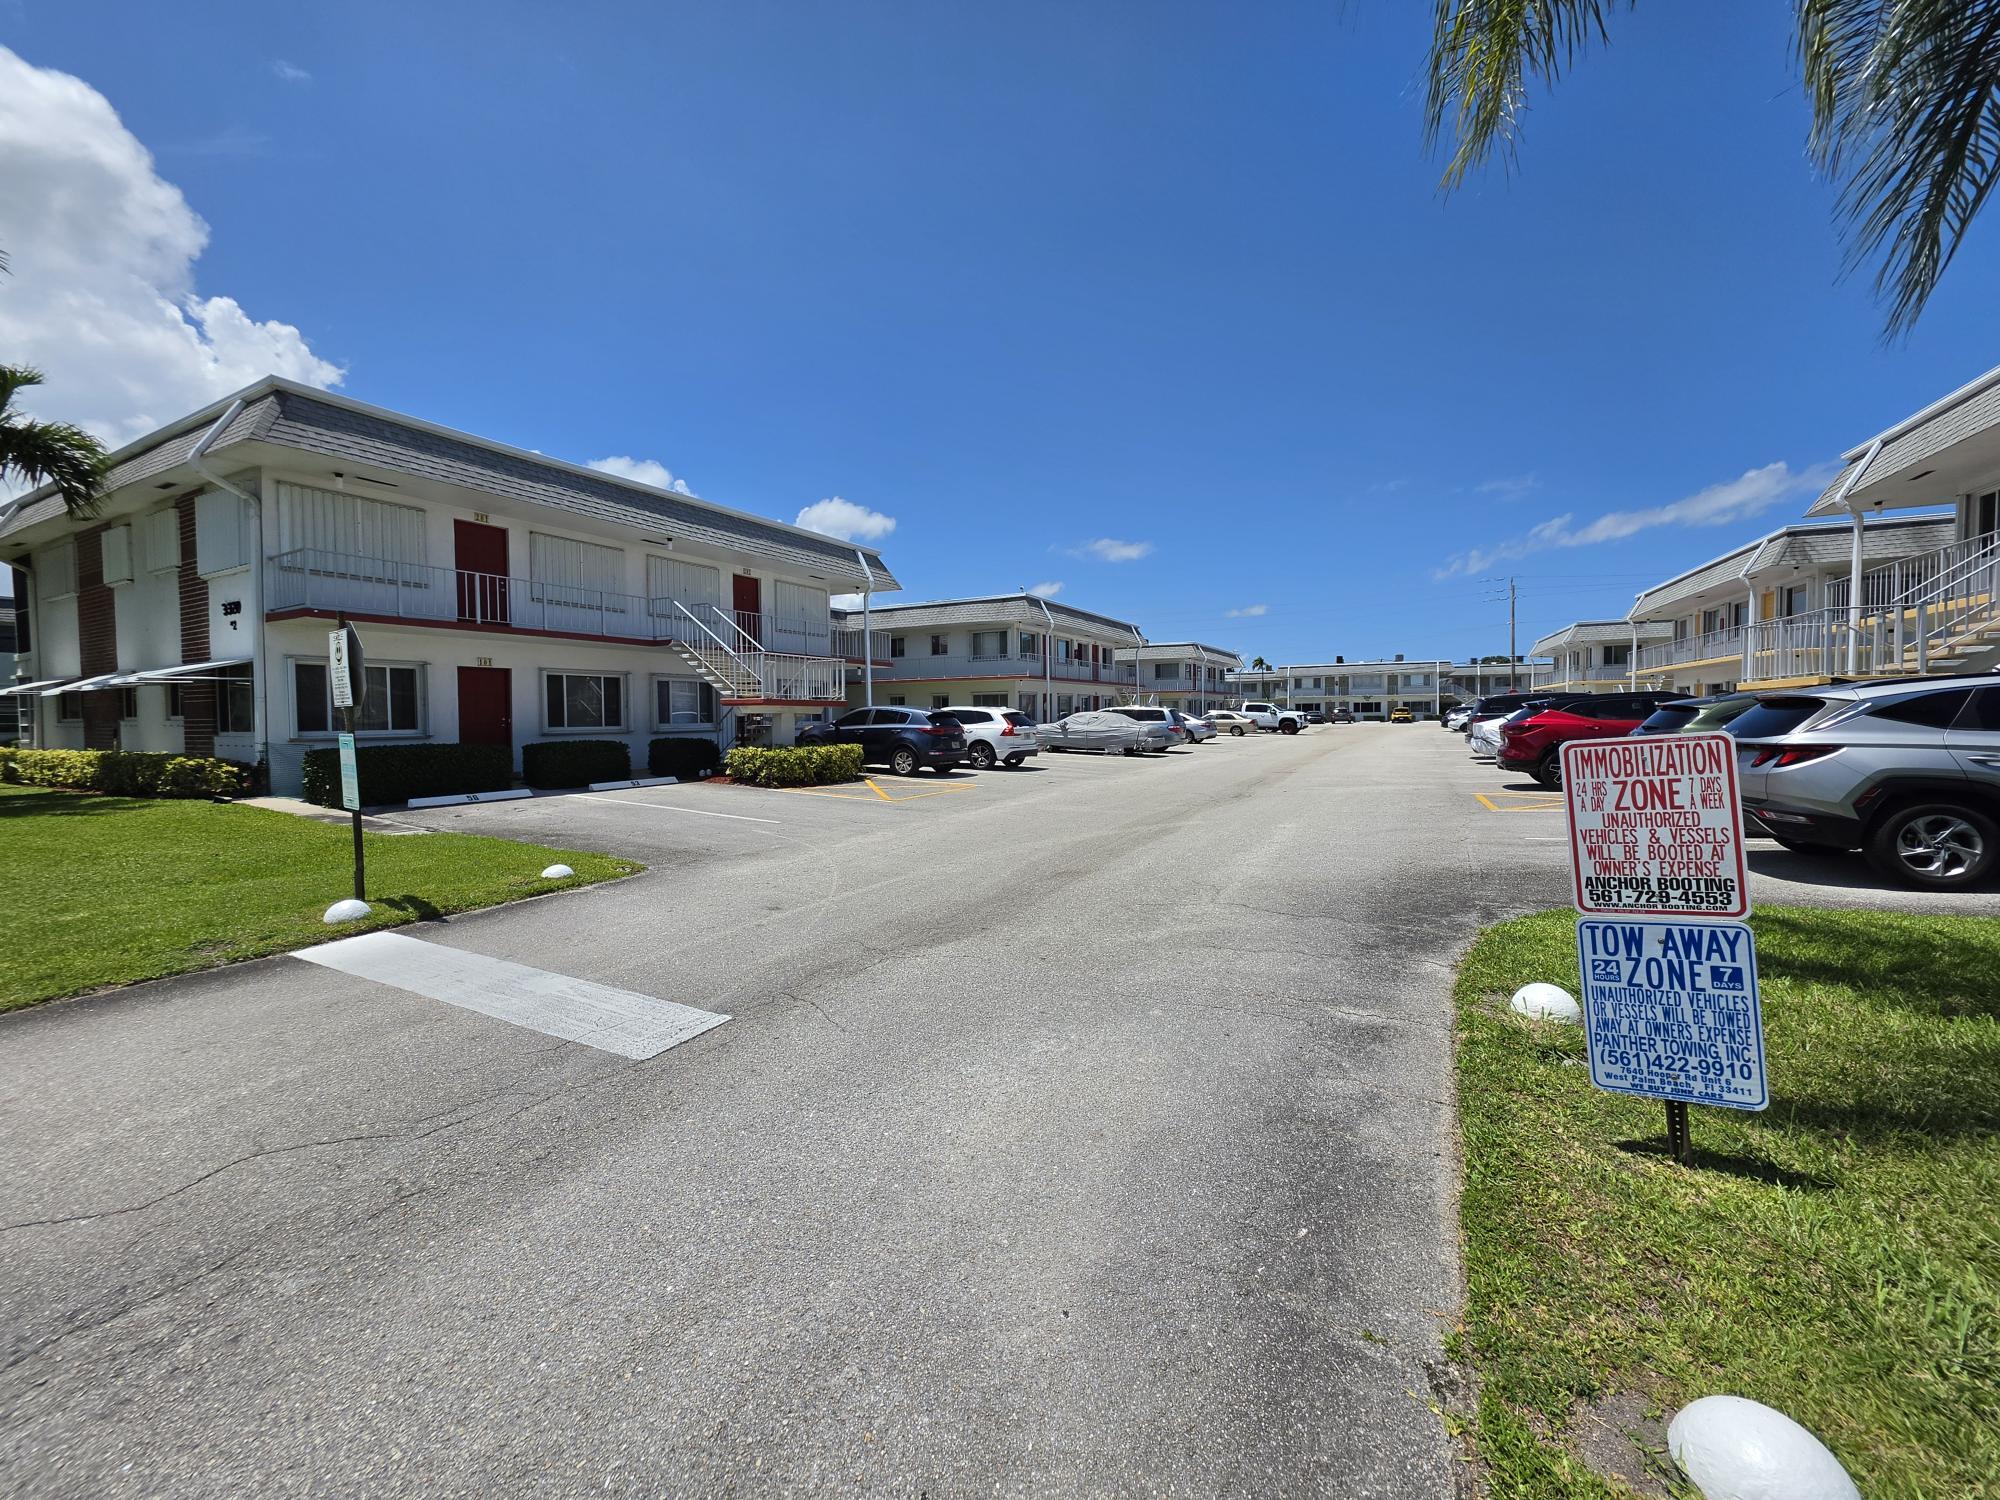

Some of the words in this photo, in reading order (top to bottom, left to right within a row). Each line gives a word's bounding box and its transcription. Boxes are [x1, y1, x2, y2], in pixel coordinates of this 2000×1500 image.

[1574, 742, 1723, 779] IMMOBILIZATION
[1576, 782, 1587, 797] 24
[1591, 781, 1607, 796] HRS
[1688, 778, 1695, 793] 7
[1700, 777, 1722, 792] DAYS
[1612, 778, 1685, 811] ZONE
[1690, 794, 1697, 810] A
[1700, 793, 1725, 809] WEEK
[1581, 797, 1587, 812] A
[1591, 796, 1605, 812] DAY
[1602, 811, 1700, 828] UNAUTHORIZED
[1579, 829, 1638, 844] VEHICLES
[1649, 829, 1661, 844] &
[1669, 827, 1730, 844] VESSELS
[1586, 845, 1615, 861] WILL
[1624, 845, 1641, 861] BE
[1648, 845, 1702, 861] BOOTED
[1711, 845, 1725, 861] AT
[1594, 861, 1651, 877] OWNER'S
[1659, 861, 1722, 877] EXPENSE
[1584, 877, 1652, 890] ANCHOR
[1657, 877, 1736, 892] BOOTING
[1661, 904, 1728, 912] BOOTING.COM
[1586, 925, 1644, 957] TOW
[1662, 928, 1742, 963] AWAY
[1593, 960, 1619, 975] 24
[1625, 957, 1706, 992] ZONE
[1719, 967, 1733, 983] 7
[1594, 974, 1620, 982] HOURS
[1713, 982, 1742, 990] DAYS
[1591, 986, 1681, 1007] UNAUTHORIZED
[1687, 992, 1749, 1013] VEHICLES
[1593, 1001, 1607, 1018] OR
[1611, 1003, 1657, 1021] VESSELS
[1662, 1007, 1688, 1024] WILL
[1692, 1009, 1707, 1026] BE
[1712, 1010, 1751, 1030] TOWED
[1595, 1017, 1623, 1034] AWAY
[1628, 1020, 1639, 1036] AT
[1645, 1021, 1692, 1041] OWNERS
[1699, 1026, 1753, 1047] EXPENSE
[1594, 1032, 1657, 1053] PANTHER
[1726, 1045, 1756, 1064] INC.
[1600, 1049, 1752, 1081] (561)422-9910
[1604, 1072, 1629, 1082] West
[1632, 1074, 1656, 1085] Palm
[1660, 1079, 1695, 1090] Beach,
[1719, 1085, 1753, 1096] 33411
[1620, 1067, 1644, 1075] 7640
[1647, 1070, 1681, 1080] Hoopr
[1685, 1074, 1698, 1082] Rd
[1701, 1076, 1721, 1084] Unit
[1630, 1082, 1645, 1090] WE
[1648, 1084, 1666, 1092] BUY
[1671, 1088, 1695, 1096] JUNK
[1698, 1091, 1724, 1099] CARS
